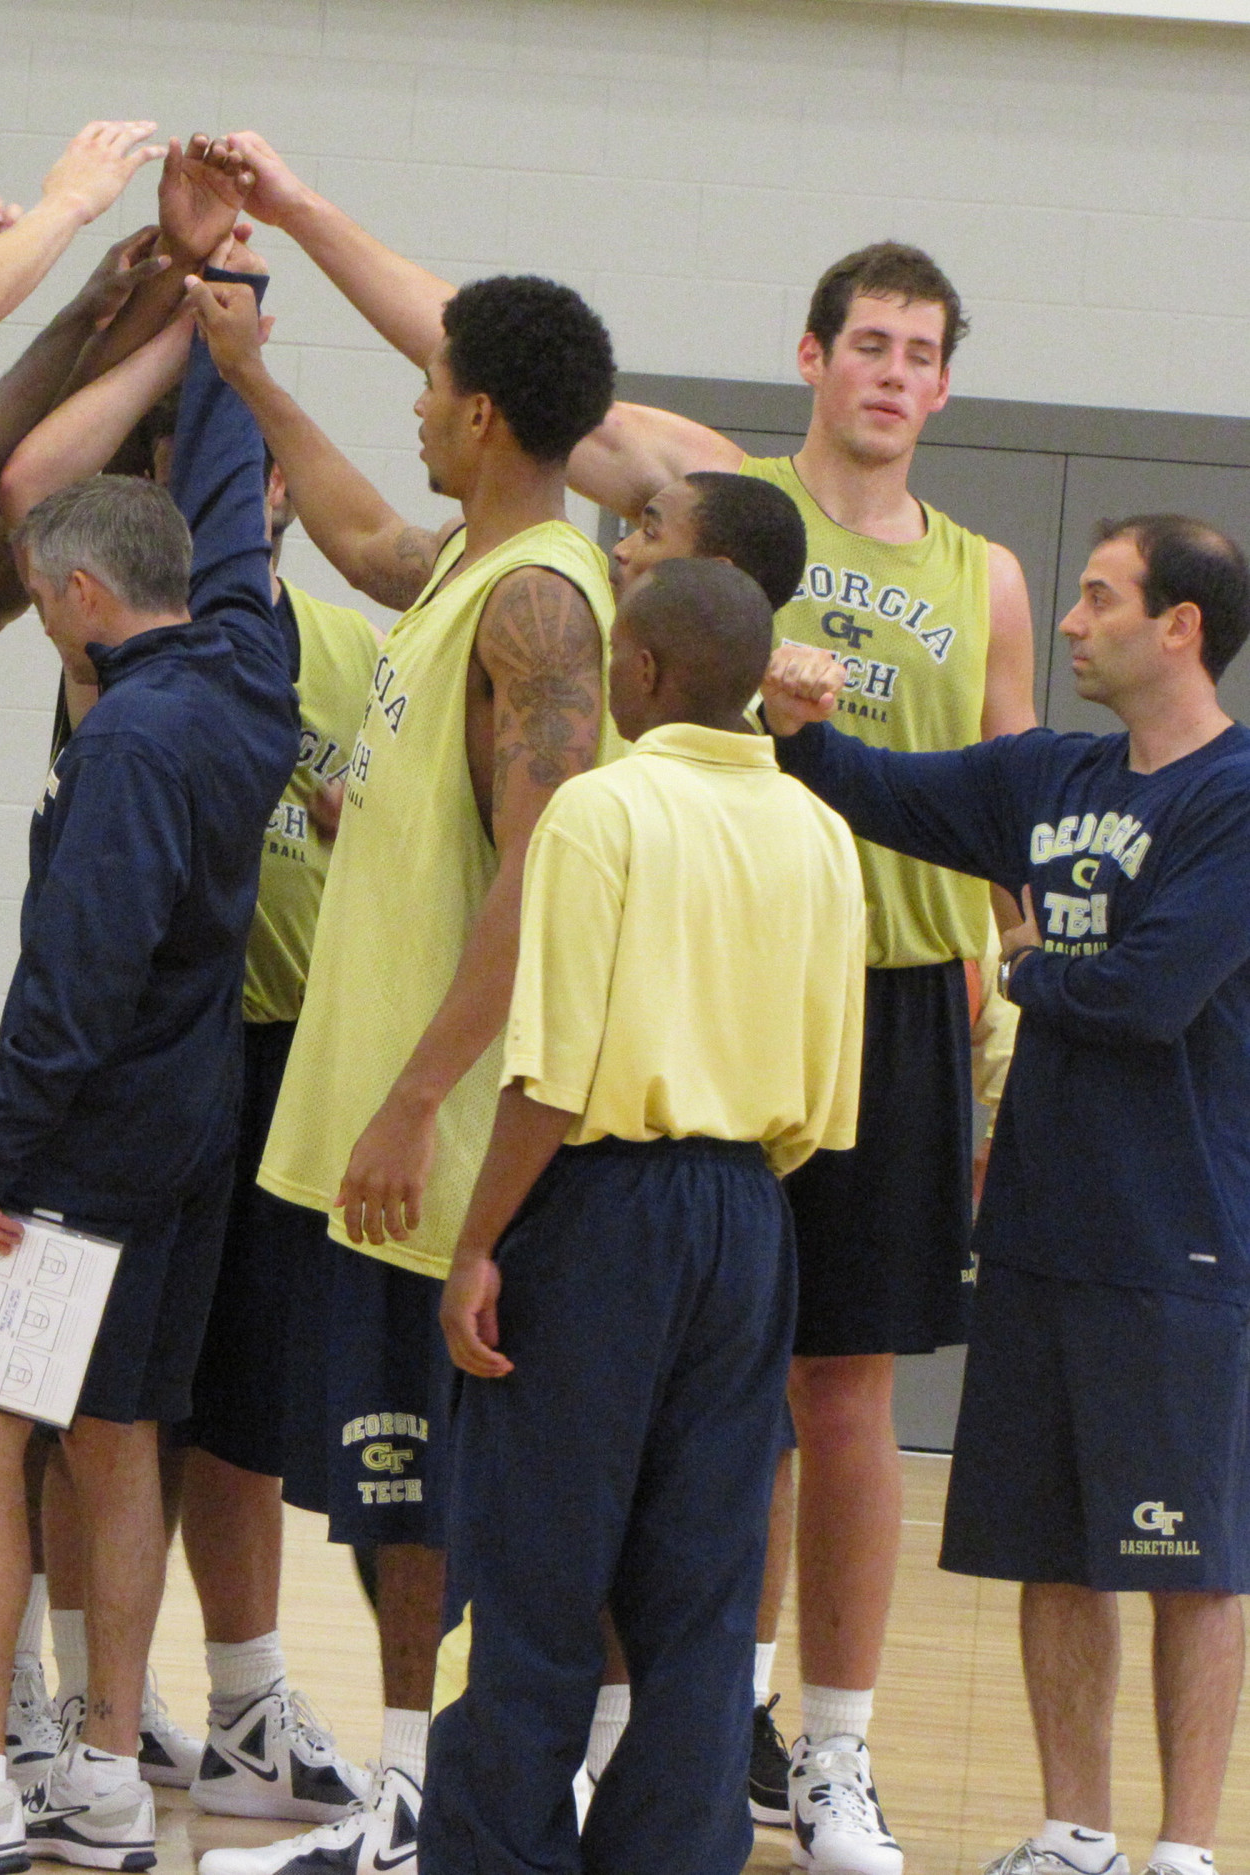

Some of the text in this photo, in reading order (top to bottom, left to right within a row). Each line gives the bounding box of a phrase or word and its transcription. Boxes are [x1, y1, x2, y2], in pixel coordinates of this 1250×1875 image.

[793, 564, 956, 664] ORGIA
[820, 610, 874, 650] GT
[361, 1442, 414, 1475] GT
[357, 1479, 423, 1504] TECH
[1132, 1501, 1184, 1536] GT
[1119, 1540, 1200, 1556] BASKETBALL
